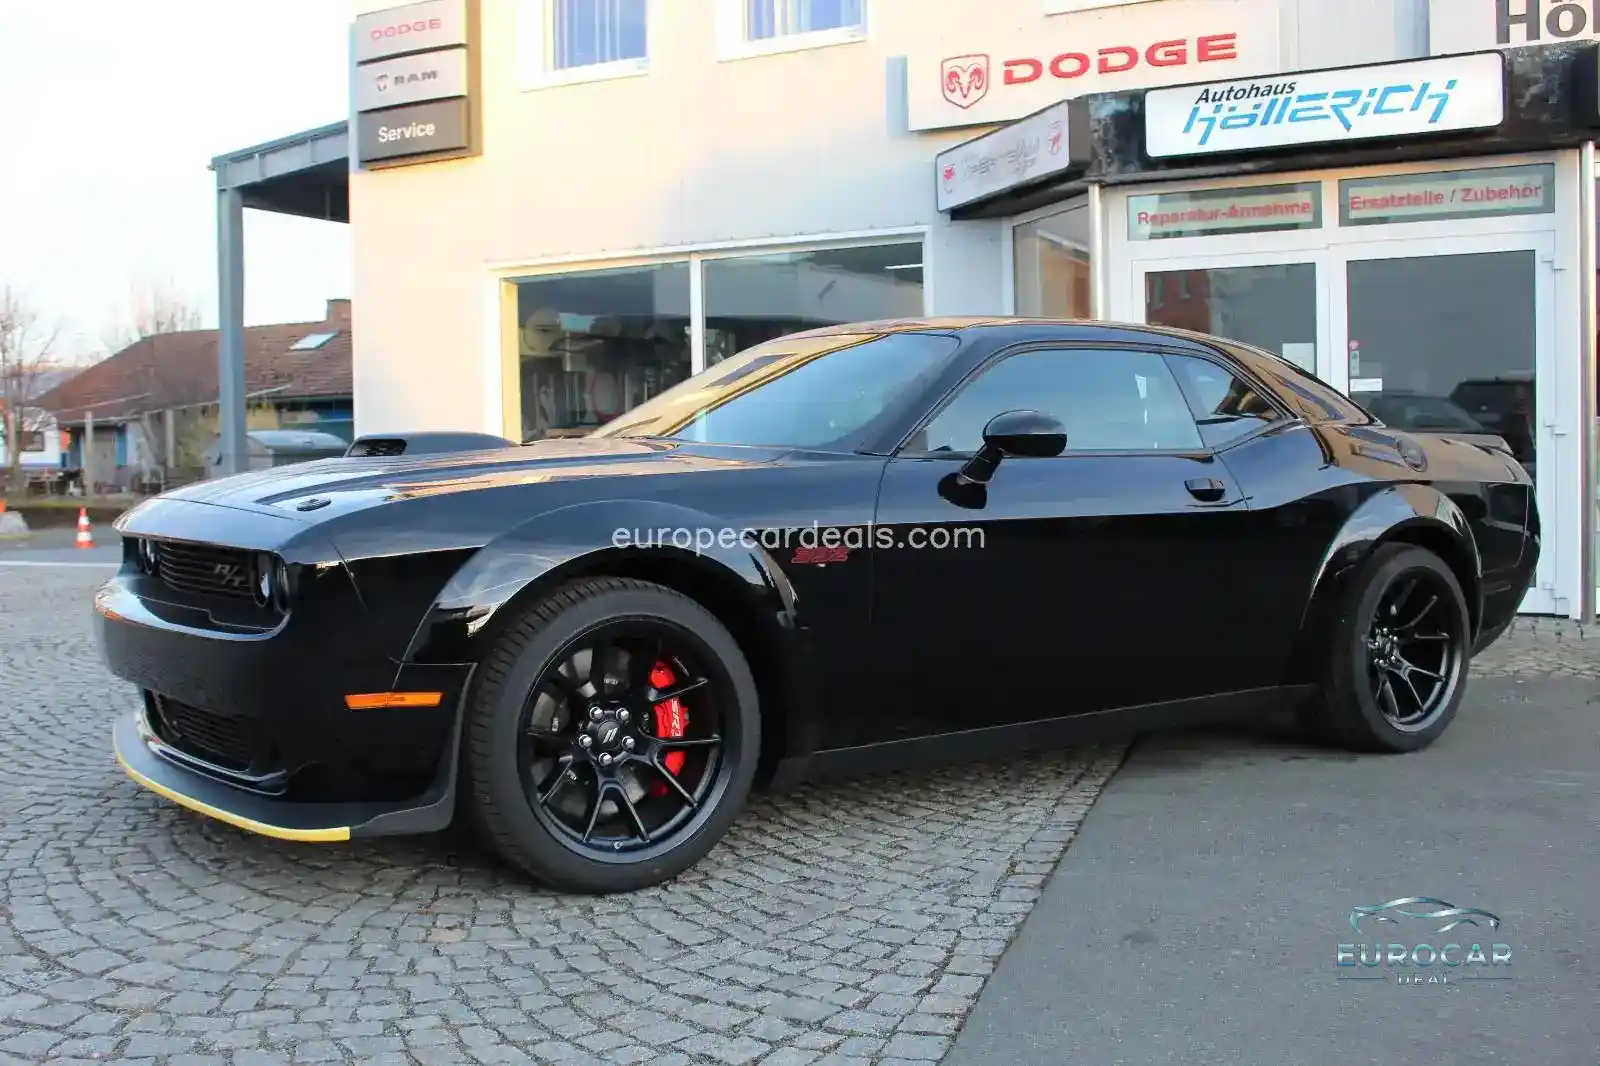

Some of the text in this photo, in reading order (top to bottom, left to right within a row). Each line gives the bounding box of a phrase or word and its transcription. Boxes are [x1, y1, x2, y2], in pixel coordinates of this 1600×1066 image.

[370, 18, 442, 41] DODGE
[1003, 33, 1237, 86] DODGE
[394, 70, 438, 86] RAM
[1196, 79, 1296, 105] Autohaus
[378, 122, 436, 143] Service
[1350, 189, 1445, 211] Ersatzteile
[1460, 182, 1543, 204] Zubehör
